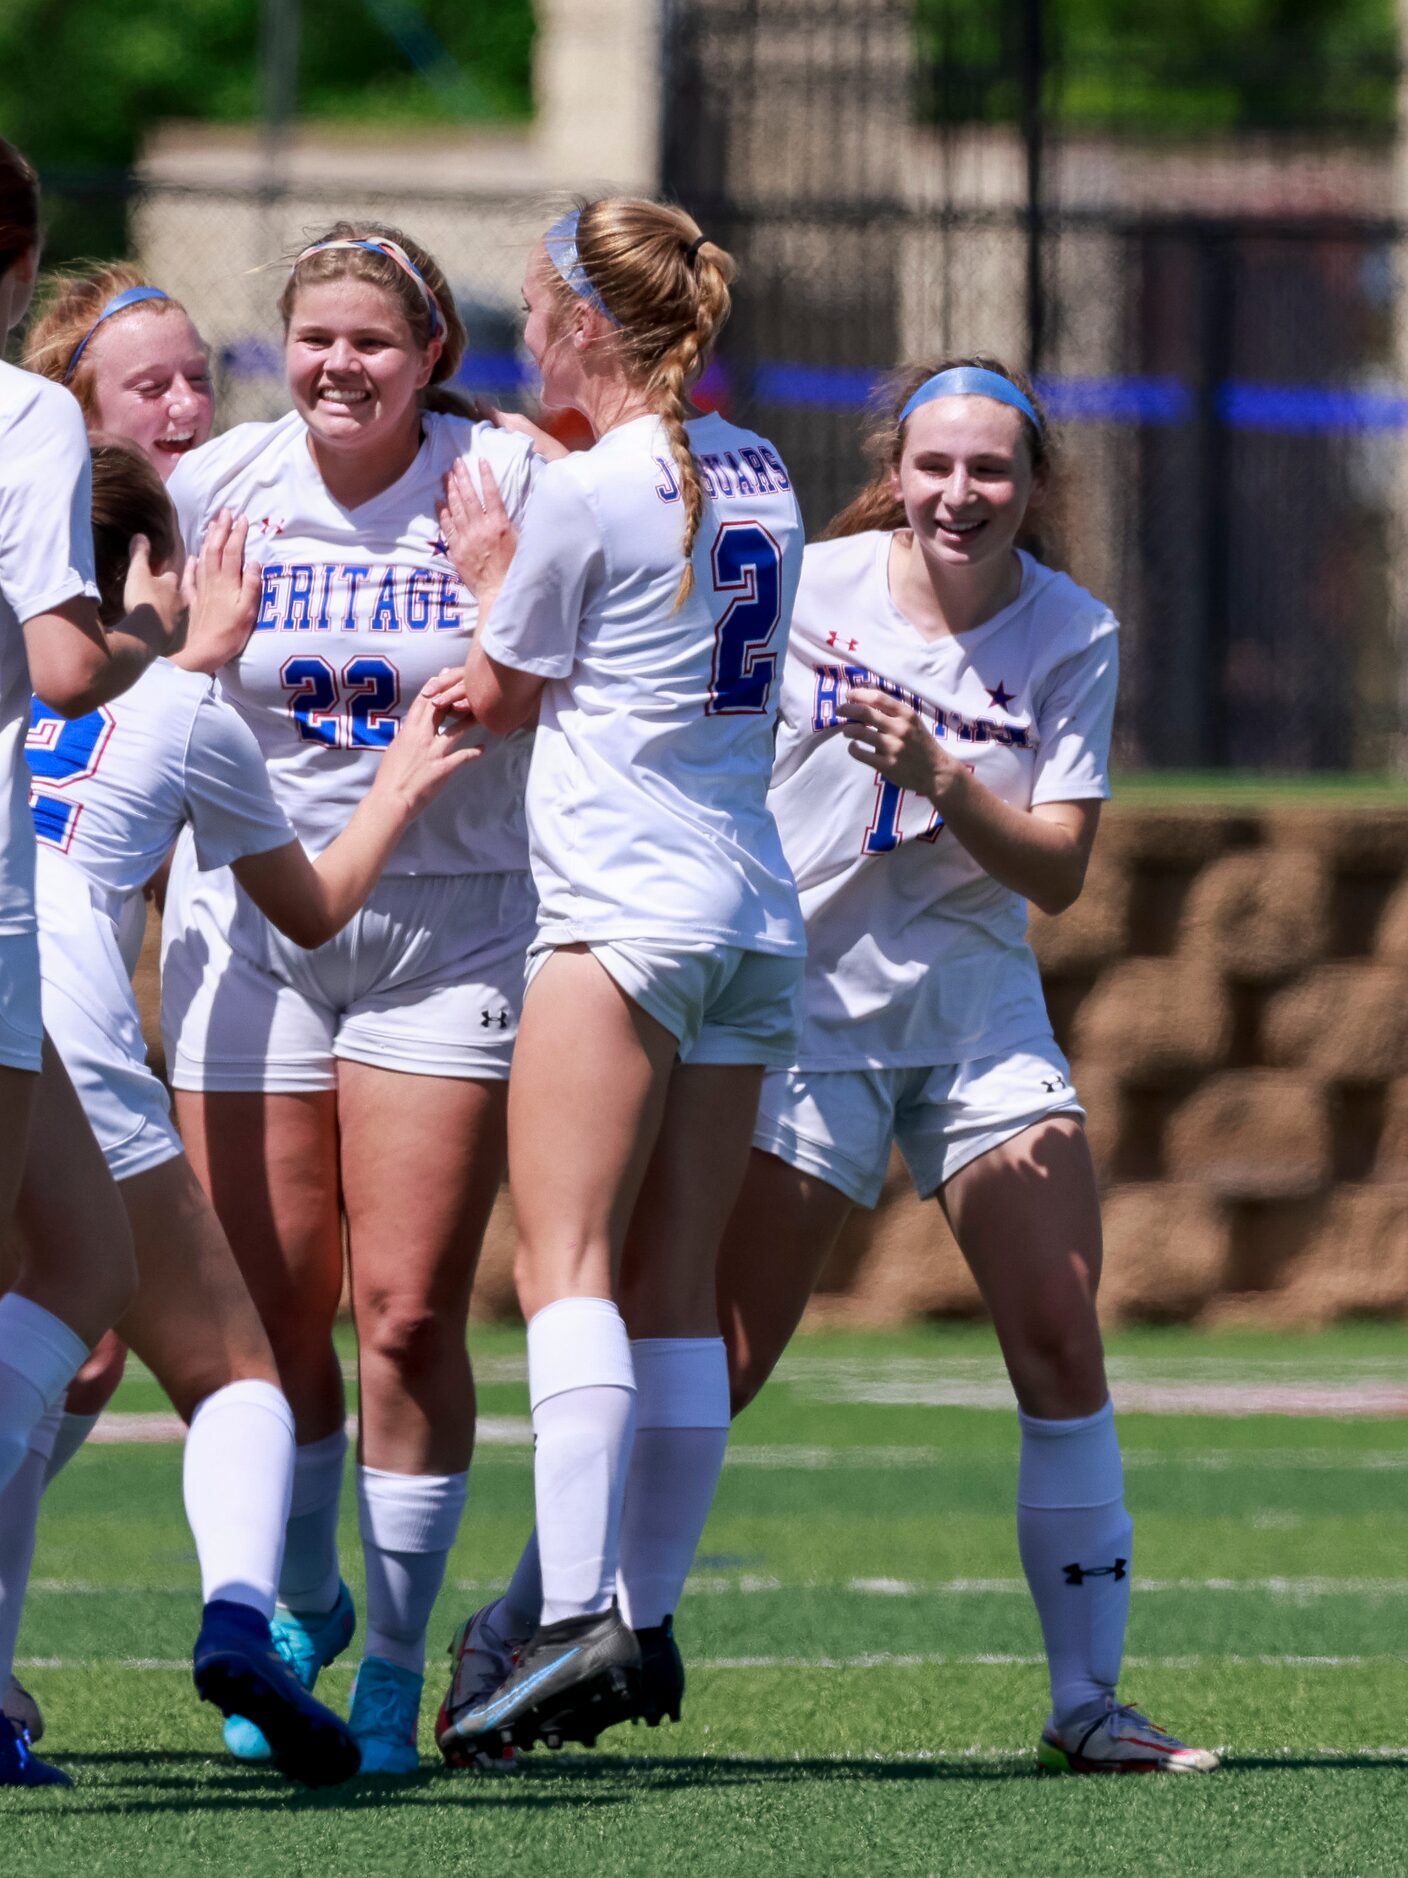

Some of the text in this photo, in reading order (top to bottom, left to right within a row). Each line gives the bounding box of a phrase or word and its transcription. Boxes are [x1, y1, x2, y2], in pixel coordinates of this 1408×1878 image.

[253, 563, 464, 633] ERITAGE
[704, 520, 783, 716] 2
[280, 655, 400, 751] 22
